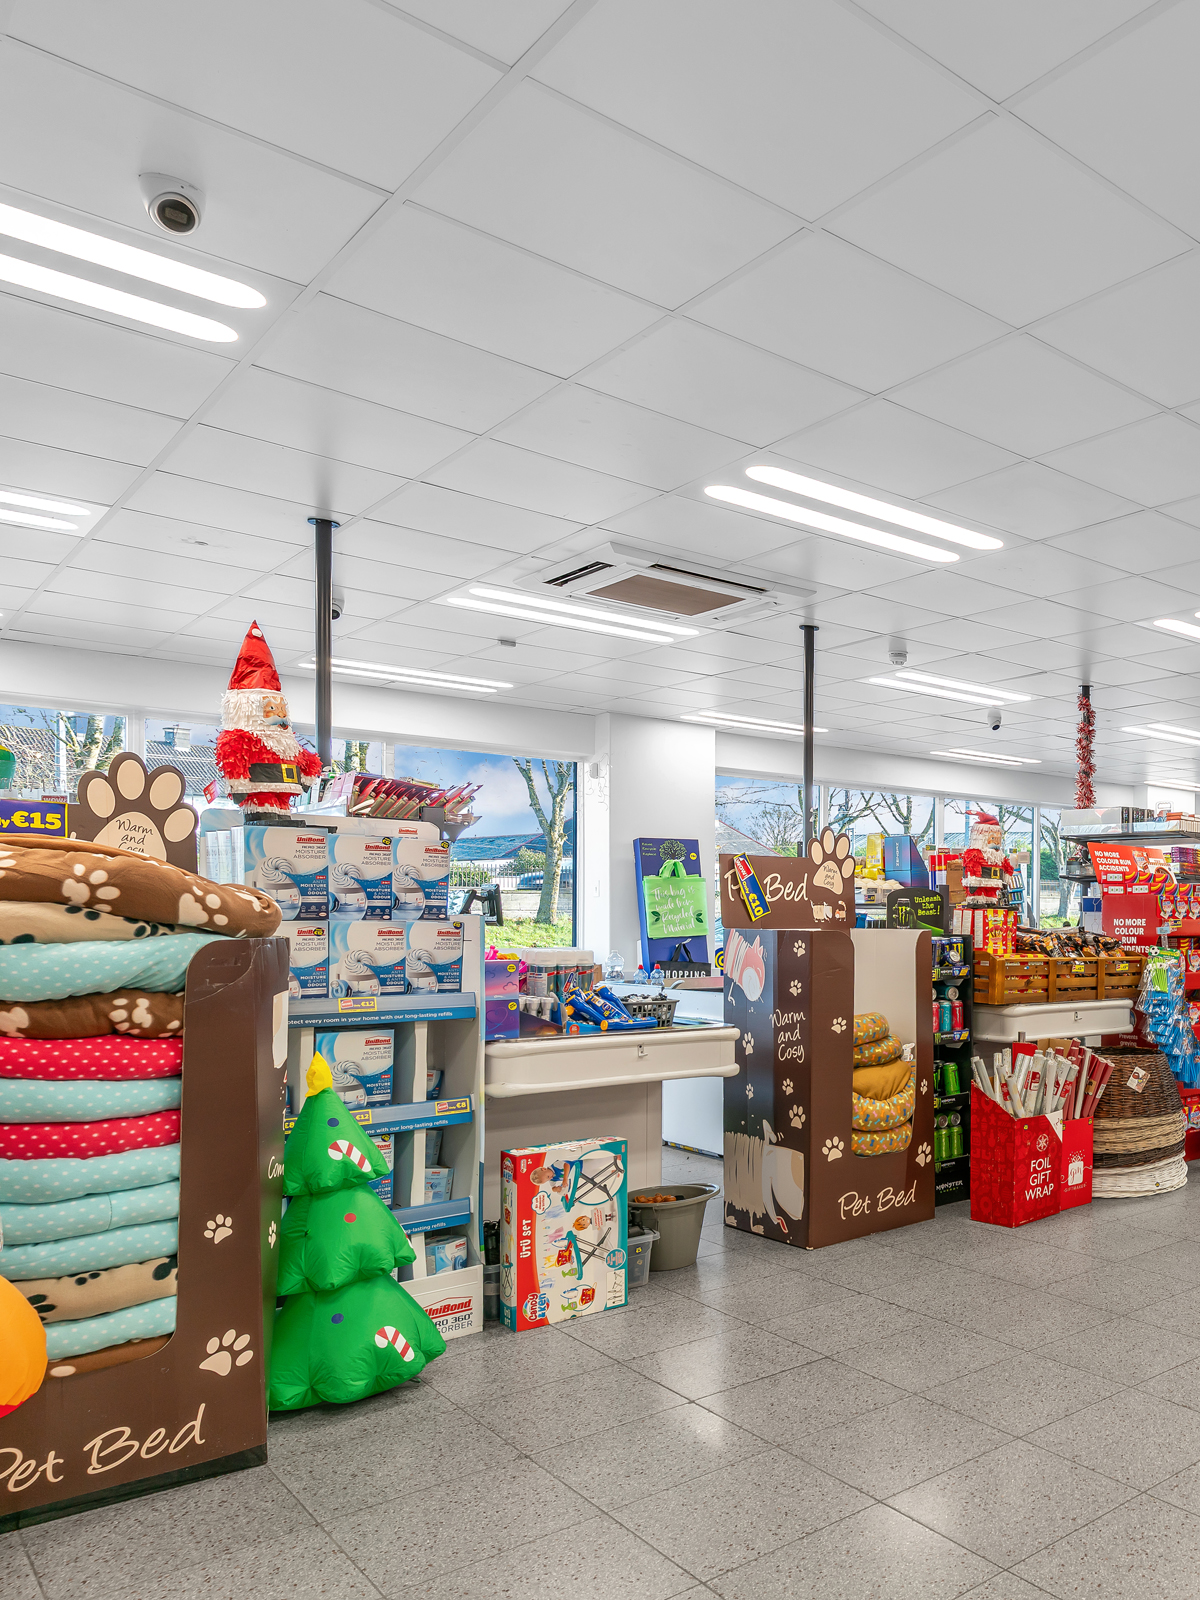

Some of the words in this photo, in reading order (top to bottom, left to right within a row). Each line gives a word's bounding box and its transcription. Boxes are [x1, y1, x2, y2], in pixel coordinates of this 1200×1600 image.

[11, 811, 61, 829] €15
[116, 819, 153, 836] Warm
[121, 834, 145, 845] and
[1103, 851, 1120, 859] MORE
[735, 857, 749, 878] WOW!
[823, 865, 838, 875] Warm
[823, 879, 835, 889] Cosy
[824, 873, 835, 881] and
[651, 886, 669, 901] This
[763, 873, 808, 902] Bed
[655, 898, 674, 911] made
[742, 881, 750, 894] Only
[748, 892, 764, 916] €10
[914, 895, 941, 904] Unleash
[660, 905, 694, 923] Recycled
[917, 905, 941, 916] Beast!
[663, 918, 695, 934] Material
[1113, 918, 1124, 926] NO
[1125, 918, 1146, 926] MORE
[1115, 927, 1144, 935] COLOUR
[1121, 936, 1137, 944] RUN
[1122, 945, 1150, 953] IDENTS
[661, 970, 706, 978] HOPPING
[769, 1008, 806, 1028] Warm
[777, 1026, 801, 1043] and
[778, 1044, 805, 1063] Cosy
[355, 1113, 369, 1121] €12
[401, 1122, 432, 1131] long-lasting
[1031, 1156, 1051, 1172] FOIL
[1030, 1170, 1051, 1186] GIFT
[935, 1180, 963, 1191] MONSTER
[1025, 1183, 1054, 1201] WRAP
[838, 1191, 871, 1220] Pet
[877, 1180, 917, 1213] Bed
[520, 1239, 532, 1258] ÜTÜ
[425, 1298, 472, 1317] UniBond
[434, 1318, 449, 1327] RO
[438, 1320, 473, 1333] ORBER
[83, 1403, 206, 1476] Bed
